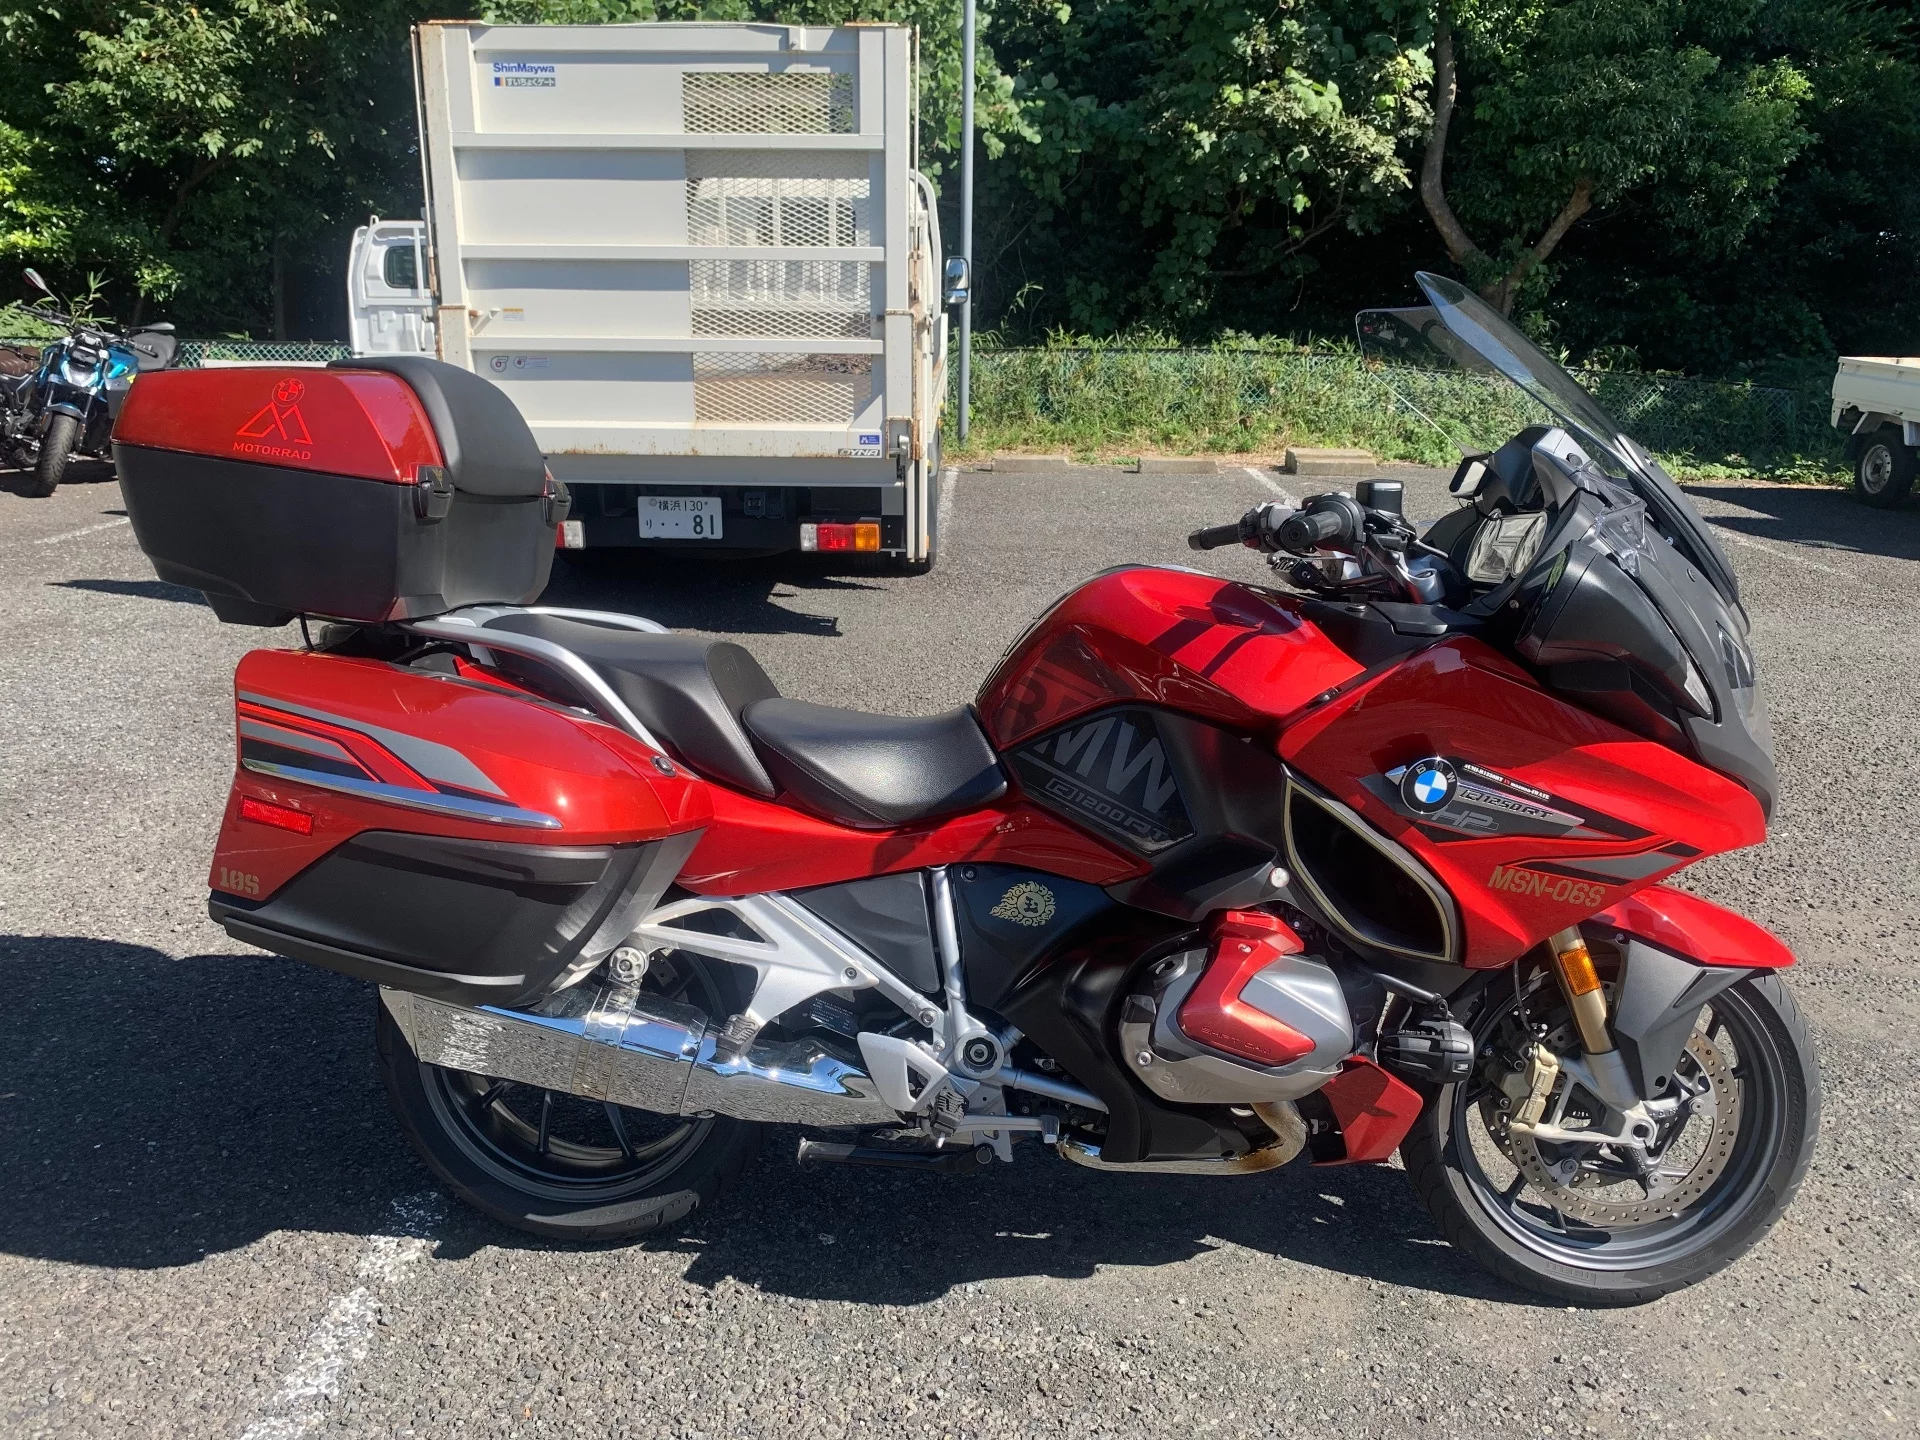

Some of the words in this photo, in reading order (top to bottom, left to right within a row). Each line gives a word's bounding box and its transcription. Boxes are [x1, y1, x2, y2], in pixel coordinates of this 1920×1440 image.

[493, 62, 555, 74] ShinMaywa
[505, 77, 556, 87] すいちょくゲート
[233, 441, 311, 460] MOTORRAD
[1488, 866, 1605, 908] MSN-06S
